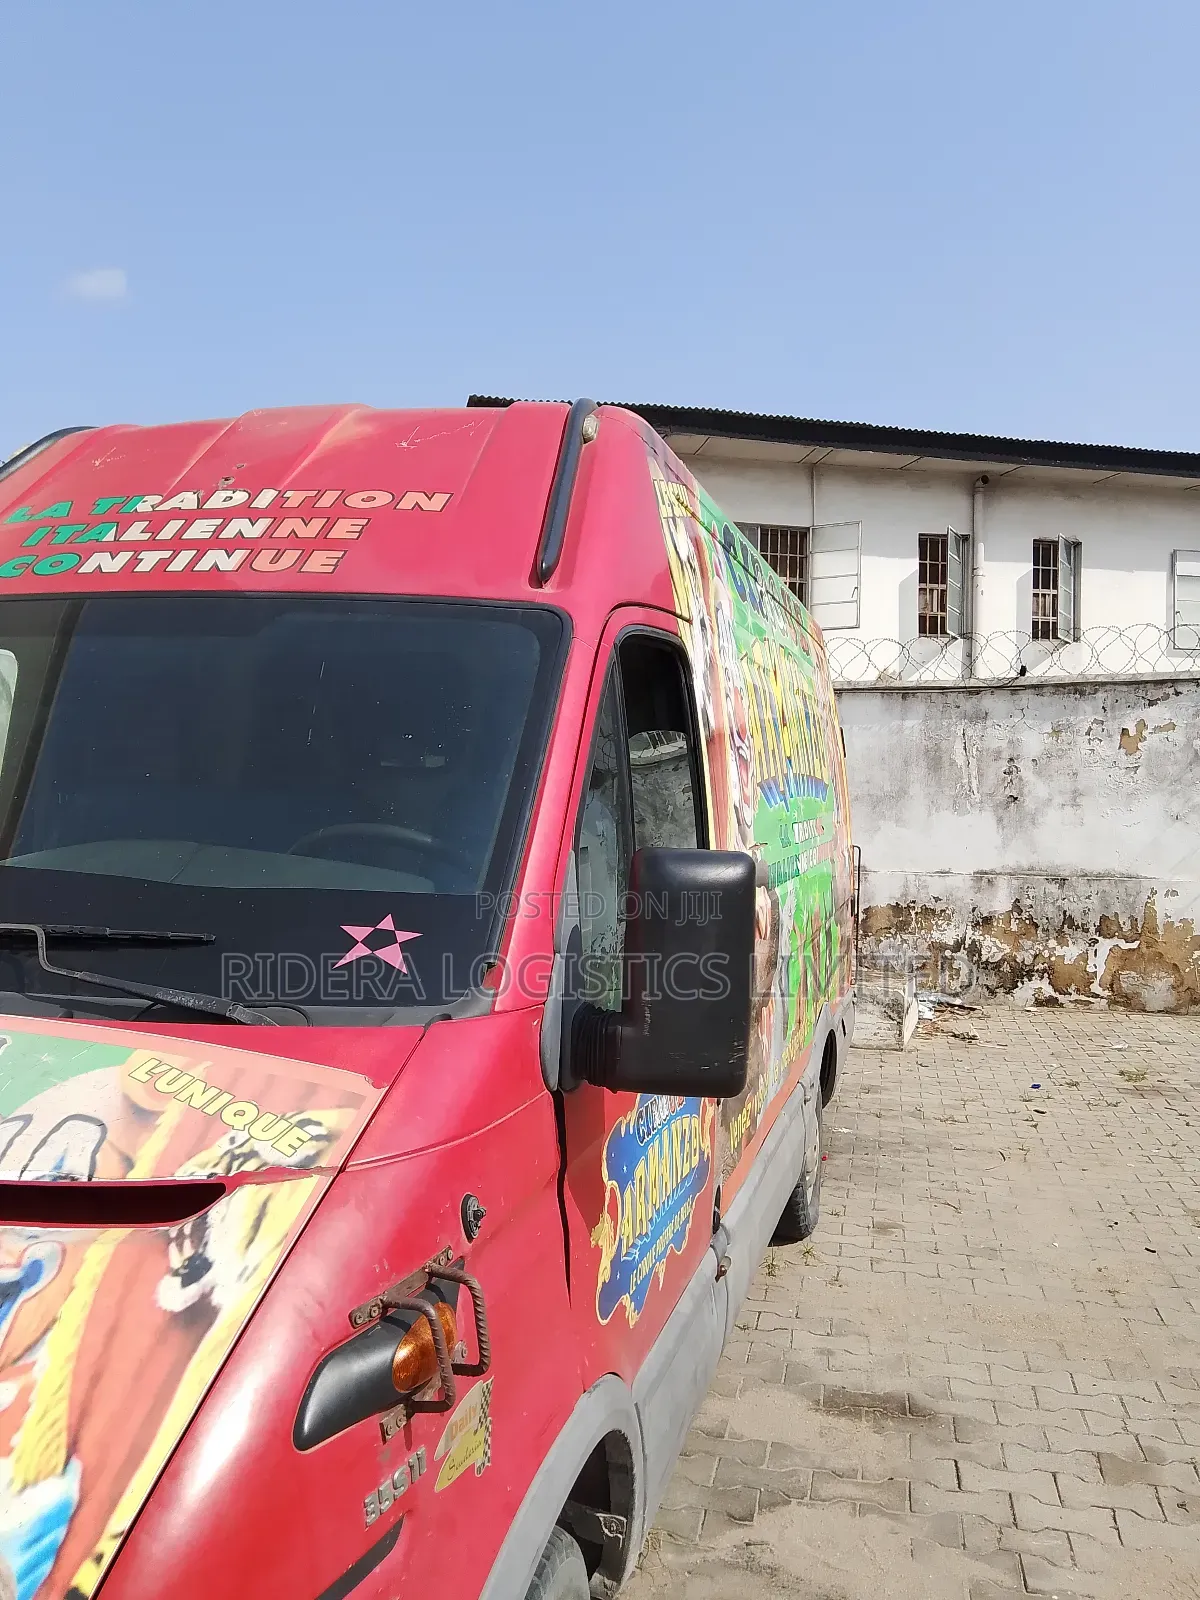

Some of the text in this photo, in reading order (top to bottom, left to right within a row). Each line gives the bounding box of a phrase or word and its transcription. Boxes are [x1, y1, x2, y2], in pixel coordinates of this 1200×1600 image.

[3, 488, 453, 526] LA TRADITION
[21, 517, 370, 548] ITALIENNE
[0, 548, 348, 578] CONTINUE
[128, 1057, 314, 1158] L'UNIQUE
